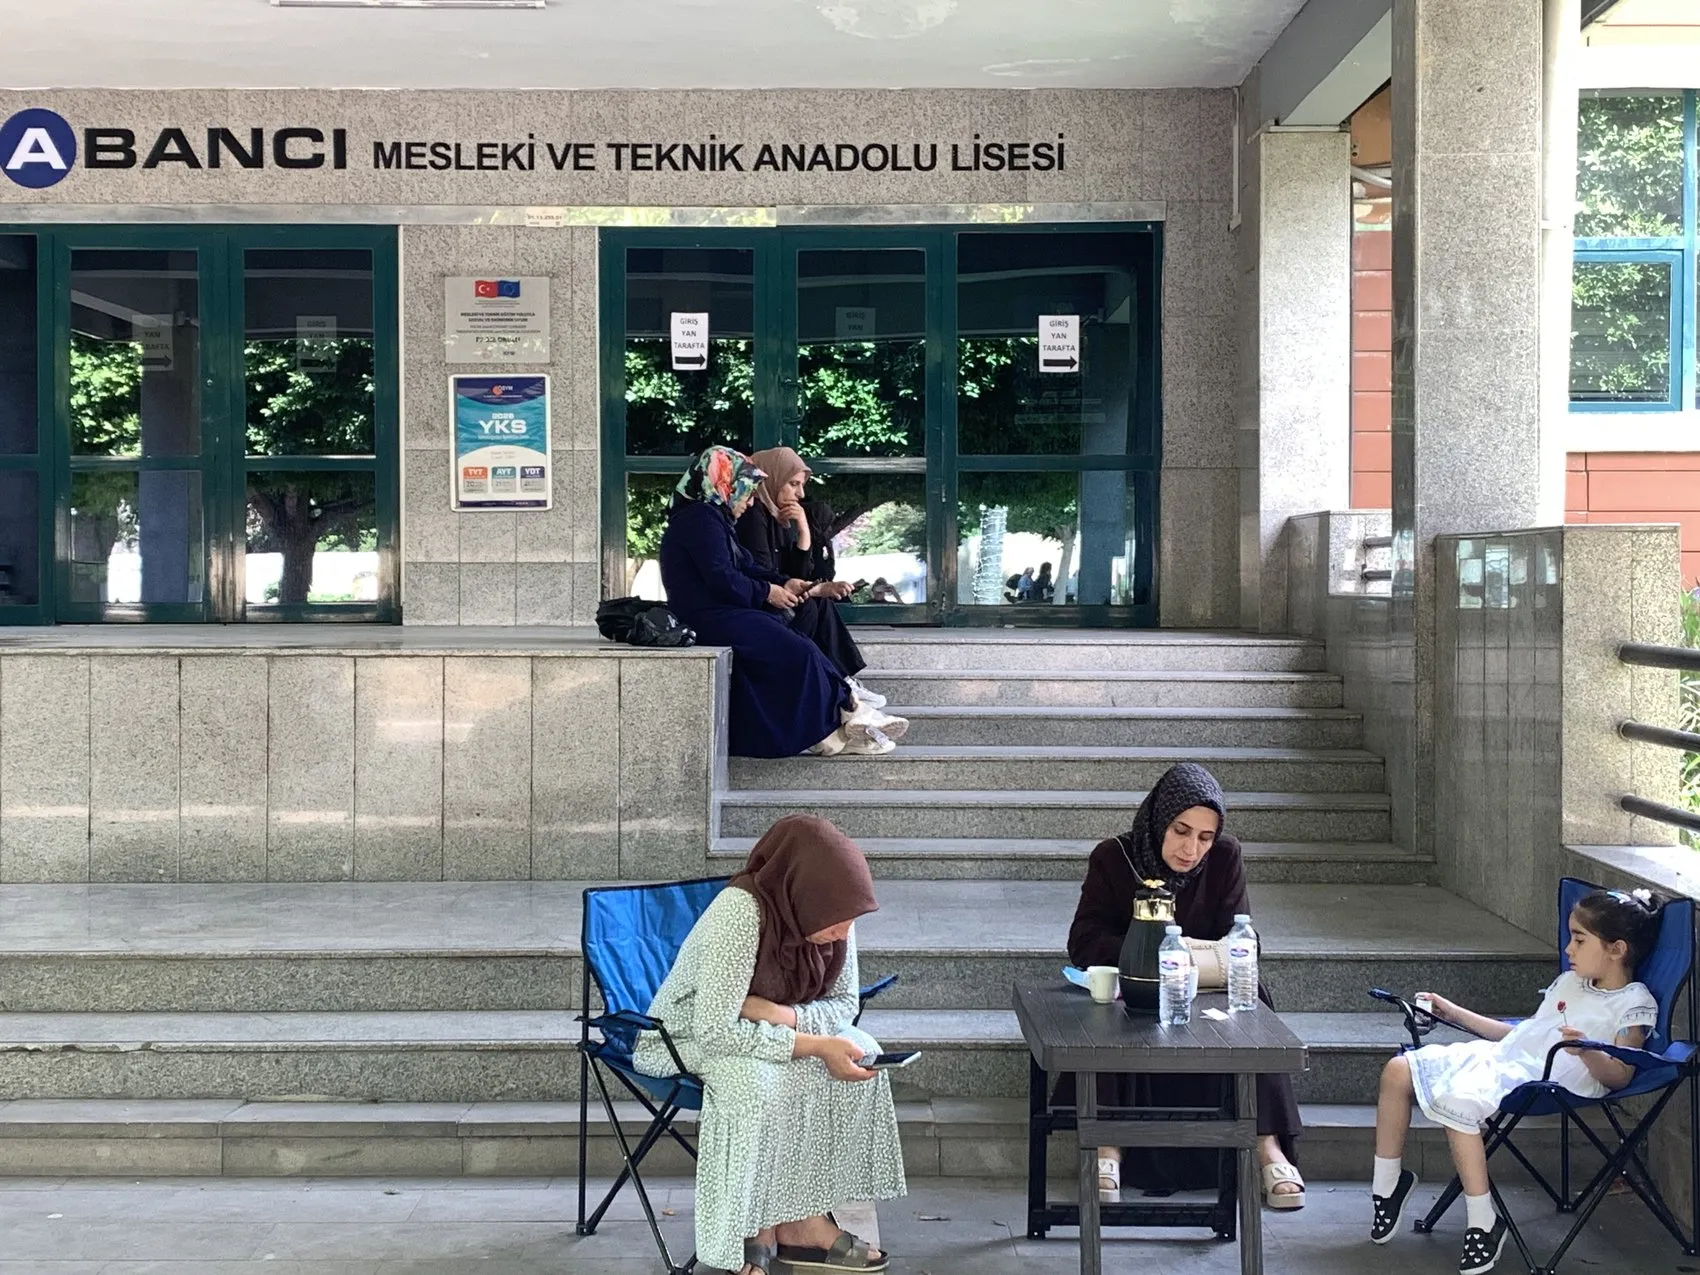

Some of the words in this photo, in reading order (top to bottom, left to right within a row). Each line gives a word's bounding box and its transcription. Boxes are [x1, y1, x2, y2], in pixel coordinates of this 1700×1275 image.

[372, 133, 536, 171] MESLEKİ
[546, 142, 596, 171] VE
[606, 133, 744, 172] TEKNİK
[752, 143, 938, 172] ANADOLU
[951, 133, 1066, 172] LİSESİ
[1049, 319, 1069, 328] GİRİŞ
[479, 419, 527, 434] YKS
[524, 467, 541, 475] YDT
